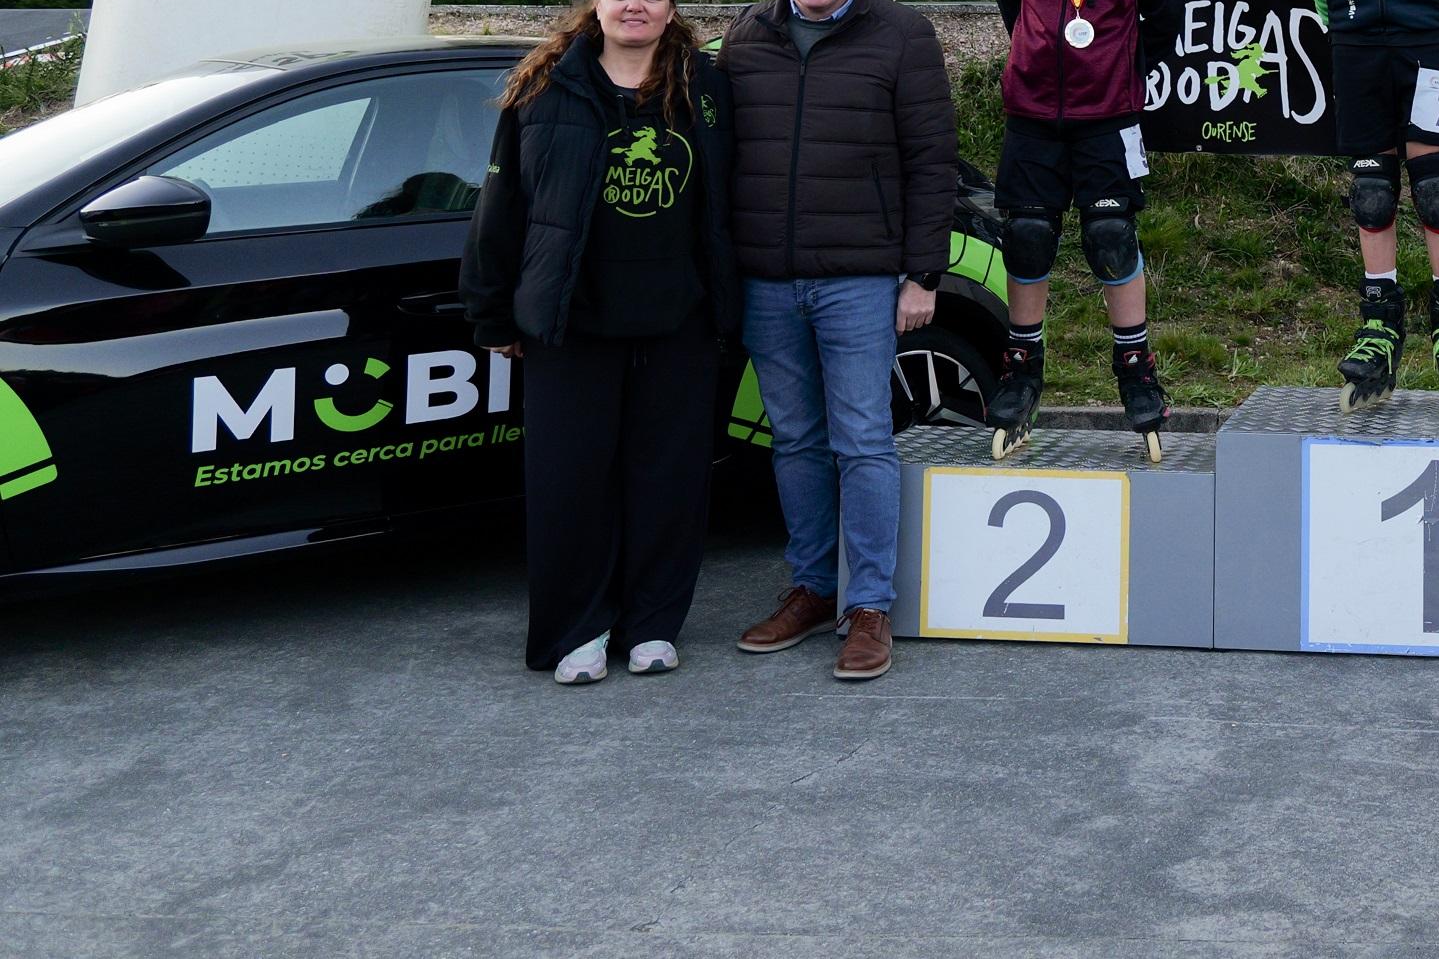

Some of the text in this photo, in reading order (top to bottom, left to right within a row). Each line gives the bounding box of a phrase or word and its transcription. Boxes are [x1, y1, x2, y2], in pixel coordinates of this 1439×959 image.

[1175, 0, 1328, 90] EIGAS
[1202, 122, 1257, 142] OURENSE
[605, 166, 679, 199] MEIGAS
[194, 449, 326, 488] Estamos
[333, 442, 413, 468] cerca
[419, 430, 484, 460] para
[982, 490, 1067, 620] 2
